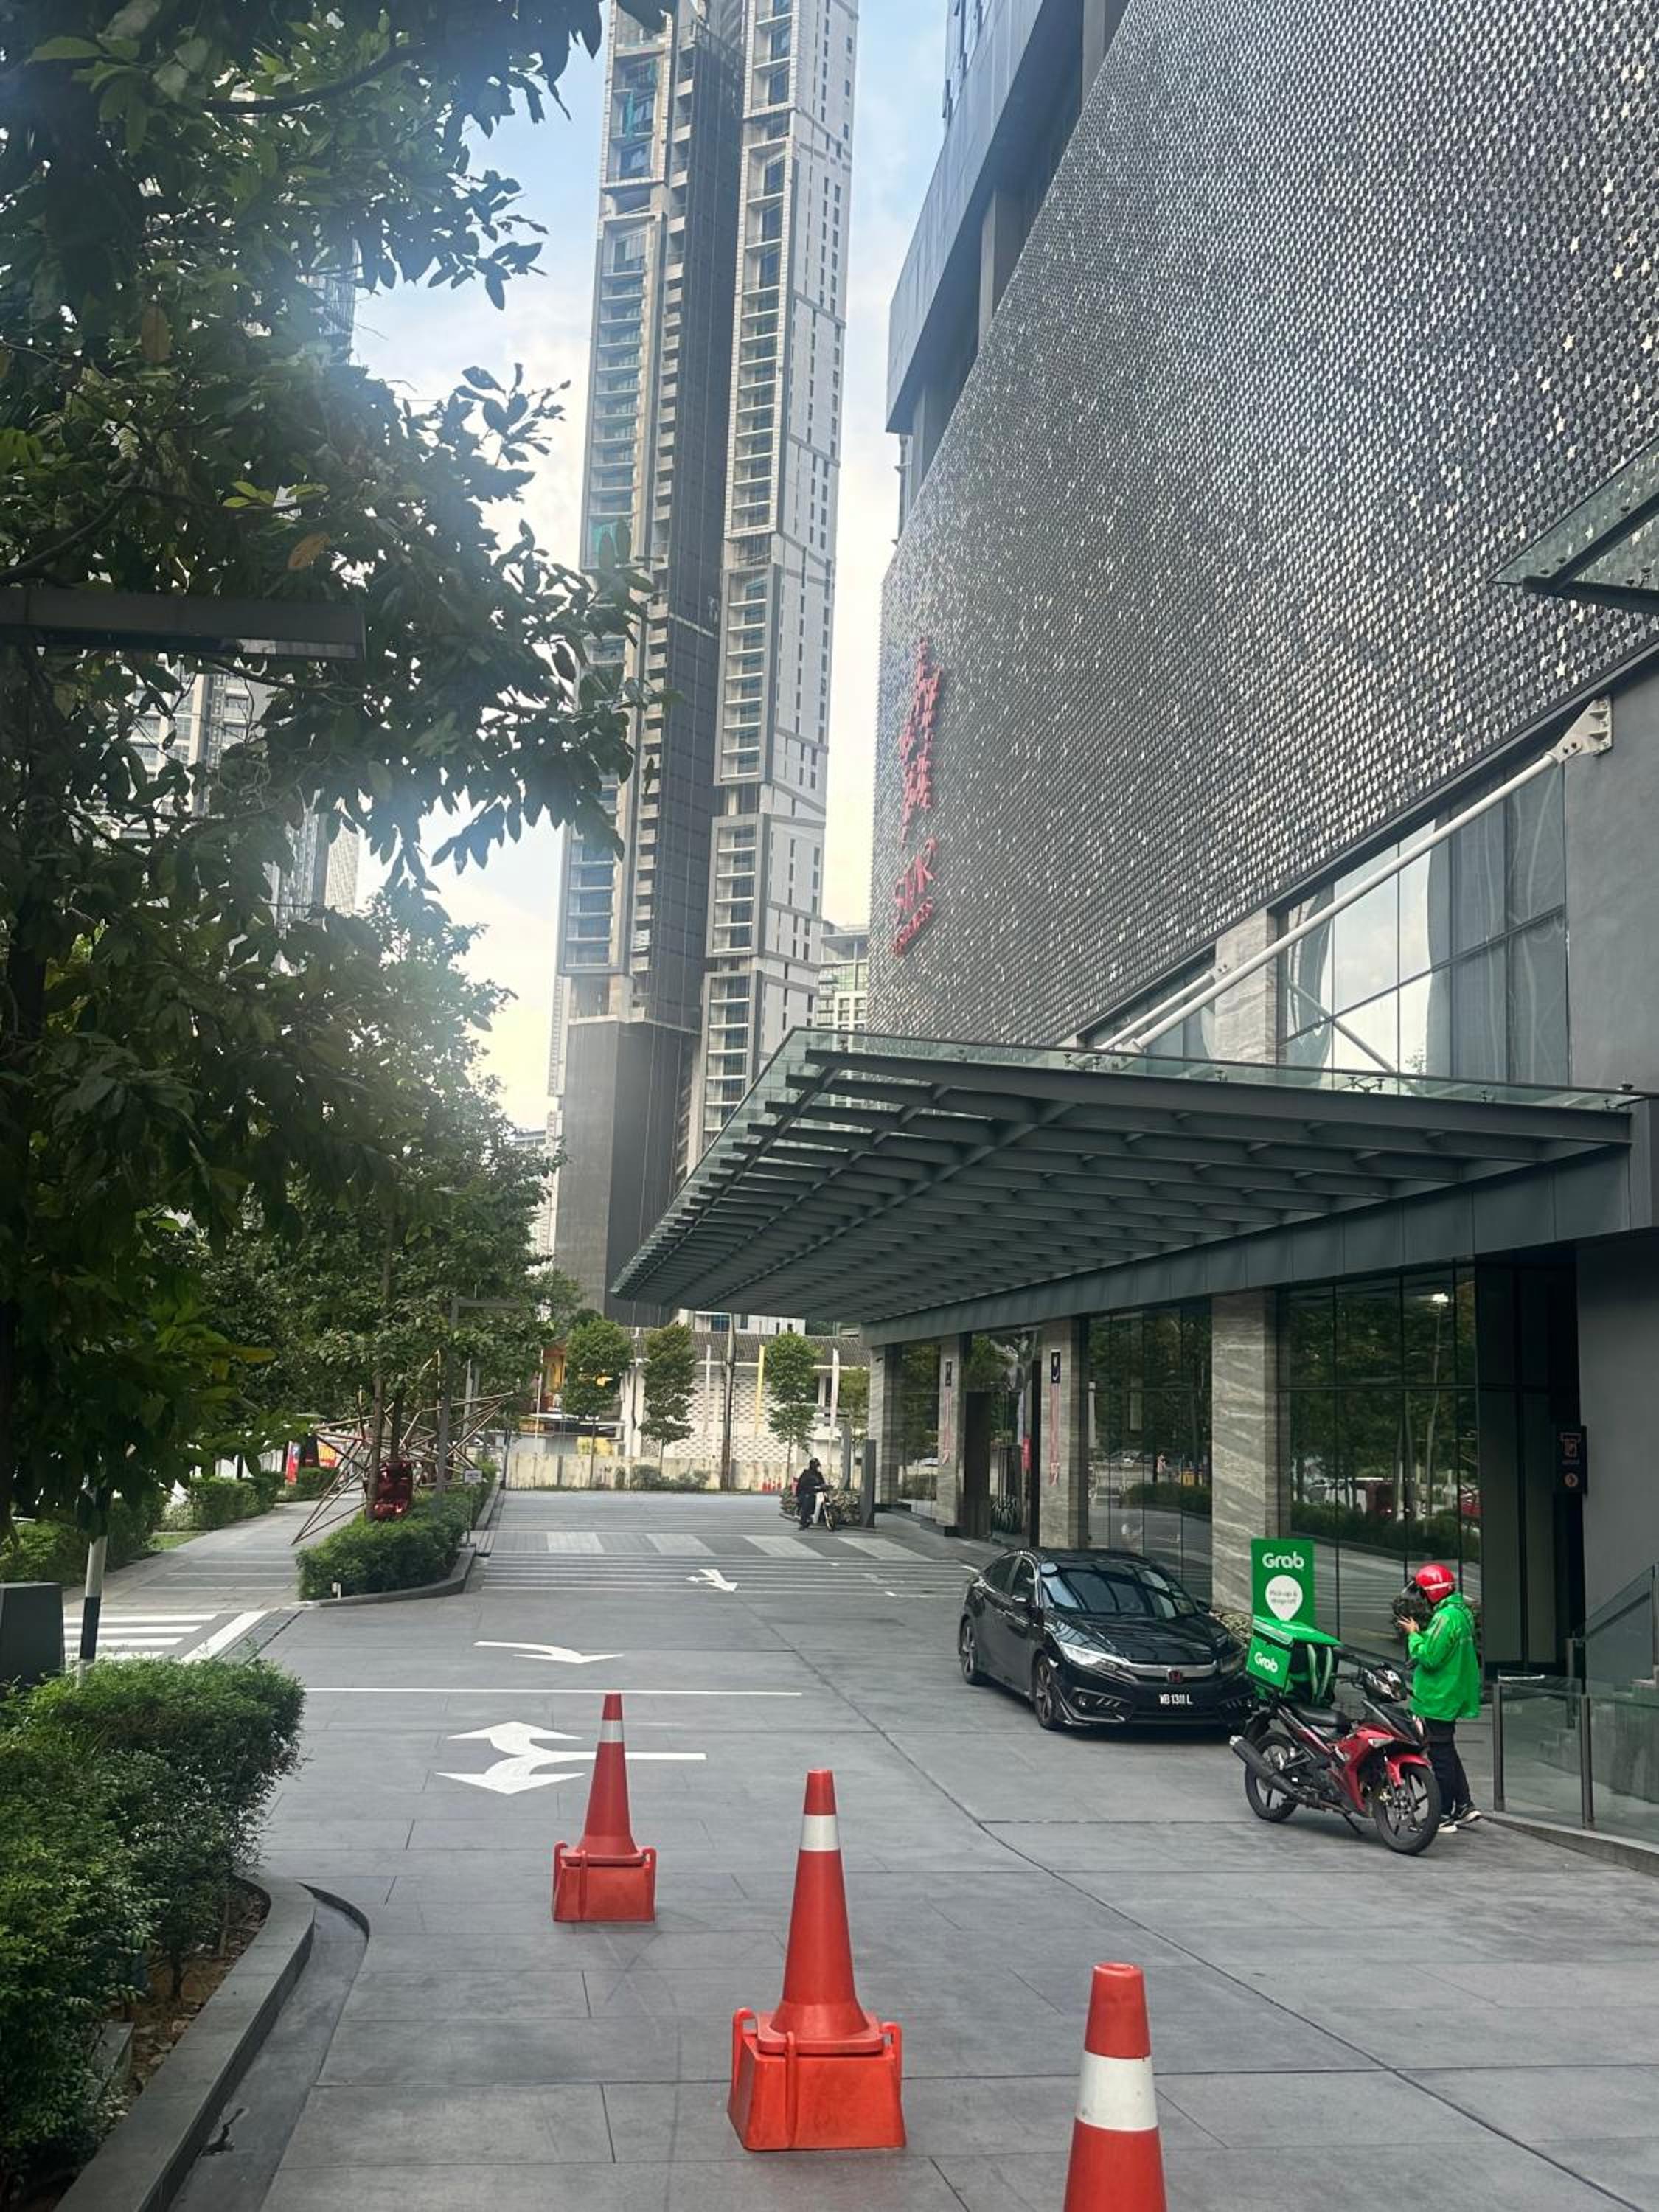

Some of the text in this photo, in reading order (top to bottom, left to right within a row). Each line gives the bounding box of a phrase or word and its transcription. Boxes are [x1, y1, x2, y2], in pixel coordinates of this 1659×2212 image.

[1262, 1551, 1304, 1569] Grab
[1254, 1651, 1278, 1673] Grab
[1186, 1694, 1194, 1705] L
